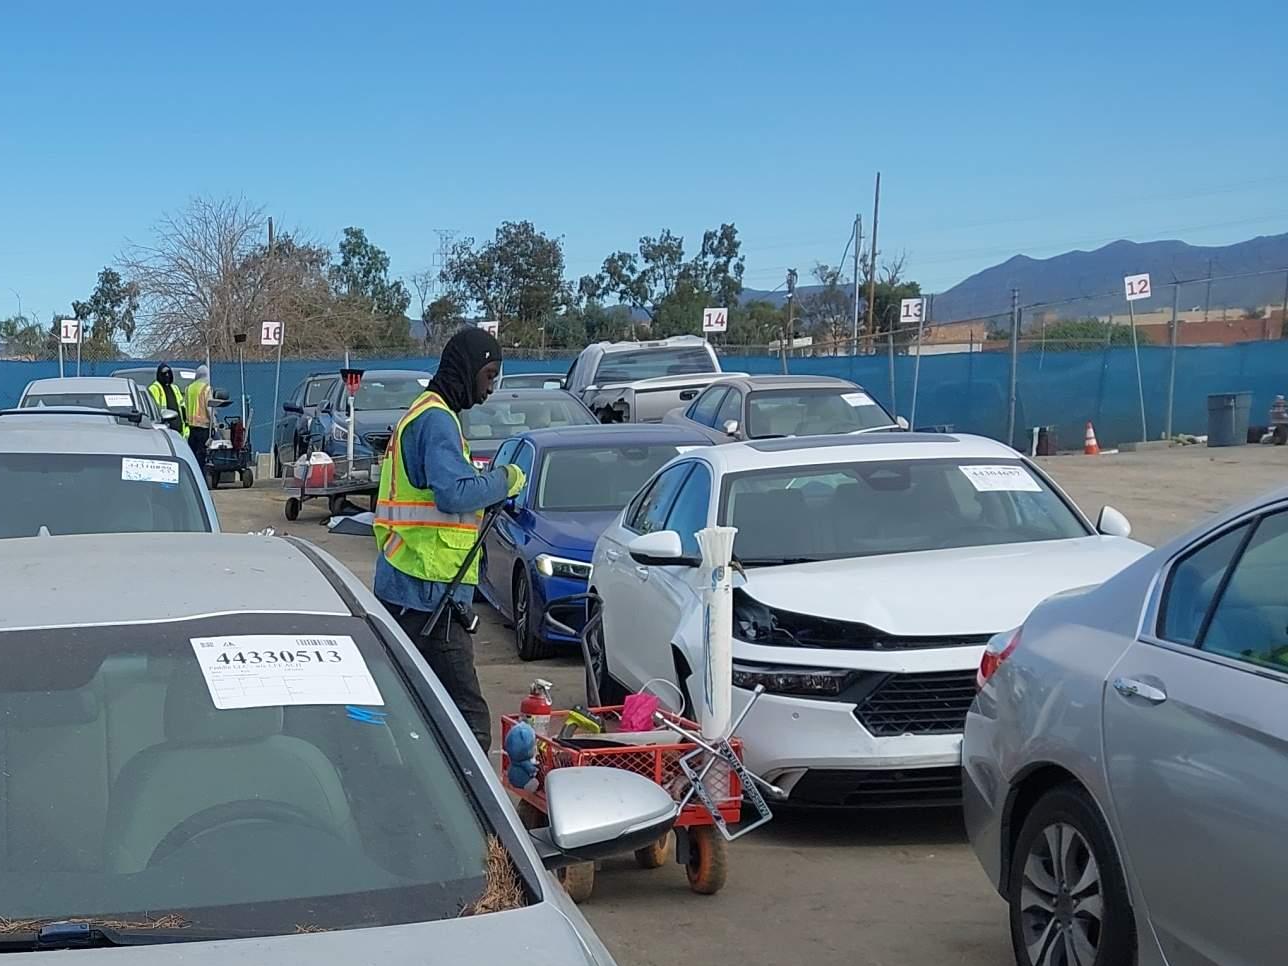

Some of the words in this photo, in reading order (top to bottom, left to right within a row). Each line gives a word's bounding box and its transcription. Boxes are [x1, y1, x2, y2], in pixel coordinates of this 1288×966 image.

[1127, 279, 1148, 296] 12
[903, 302, 923, 318] 13
[704, 312, 726, 328] 14
[62, 324, 79, 339] 17
[263, 326, 282, 341] 16
[216, 650, 343, 665] 44330513
